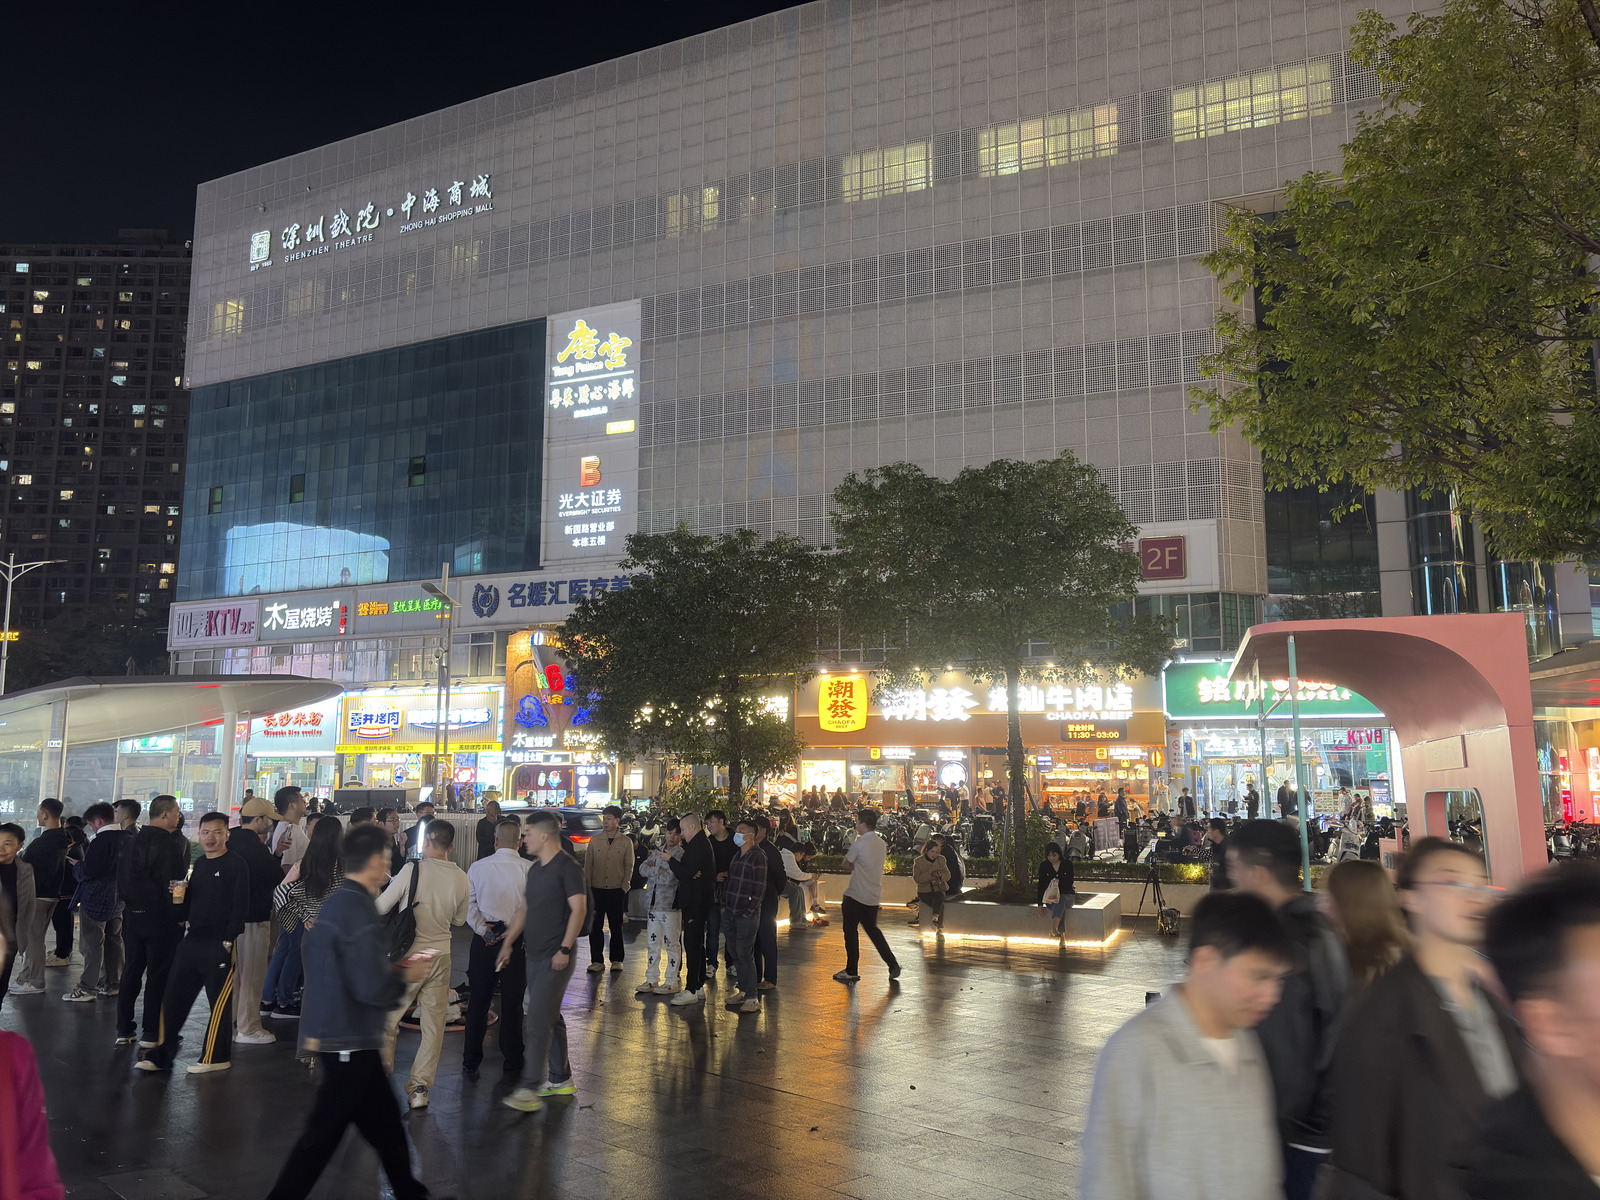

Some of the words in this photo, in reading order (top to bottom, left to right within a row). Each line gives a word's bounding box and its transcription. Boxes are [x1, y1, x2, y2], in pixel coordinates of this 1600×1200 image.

[400, 220, 423, 234] ZHONG
[424, 216, 437, 227] HAI
[438, 207, 473, 223] SHOPPING
[475, 202, 494, 214] MALL
[284, 245, 330, 263] SHENZHEN
[334, 233, 374, 250] THEATRE
[558, 488, 622, 510] 光大证券
[1147, 546, 1178, 571] 2F
[263, 602, 333, 630] 木屋烧烤
[826, 680, 857, 719] 潮發
[1047, 711, 1098, 720] CHAOFA
[1101, 711, 1133, 720] BEEF
[1067, 724, 1095, 732] 营业时间
